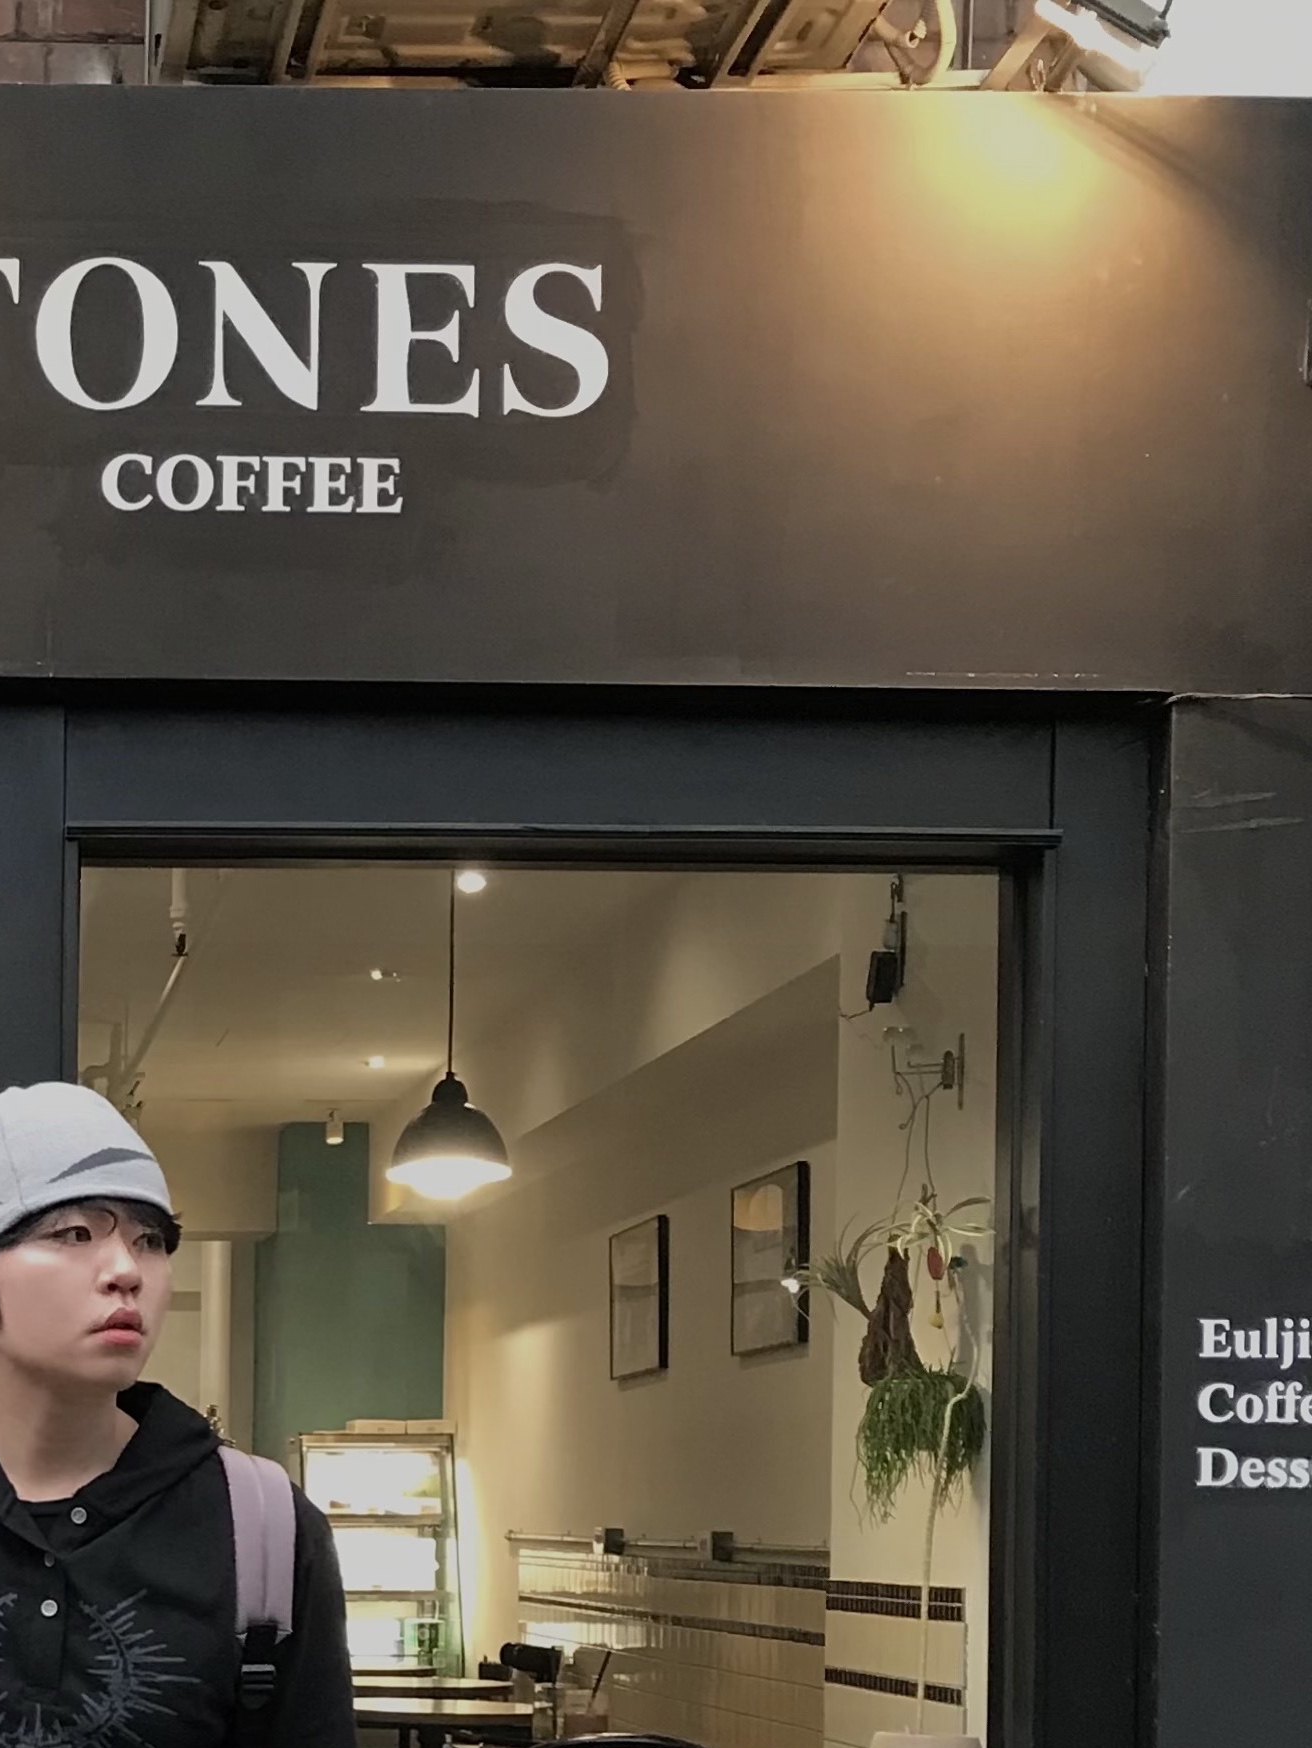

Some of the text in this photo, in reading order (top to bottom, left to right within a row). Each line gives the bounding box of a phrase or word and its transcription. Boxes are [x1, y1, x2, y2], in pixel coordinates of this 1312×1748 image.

[101, 453, 403, 514] COFFEE
[1197, 1317, 1311, 1370] Eulji
[1196, 1447, 1311, 1488] Dess
